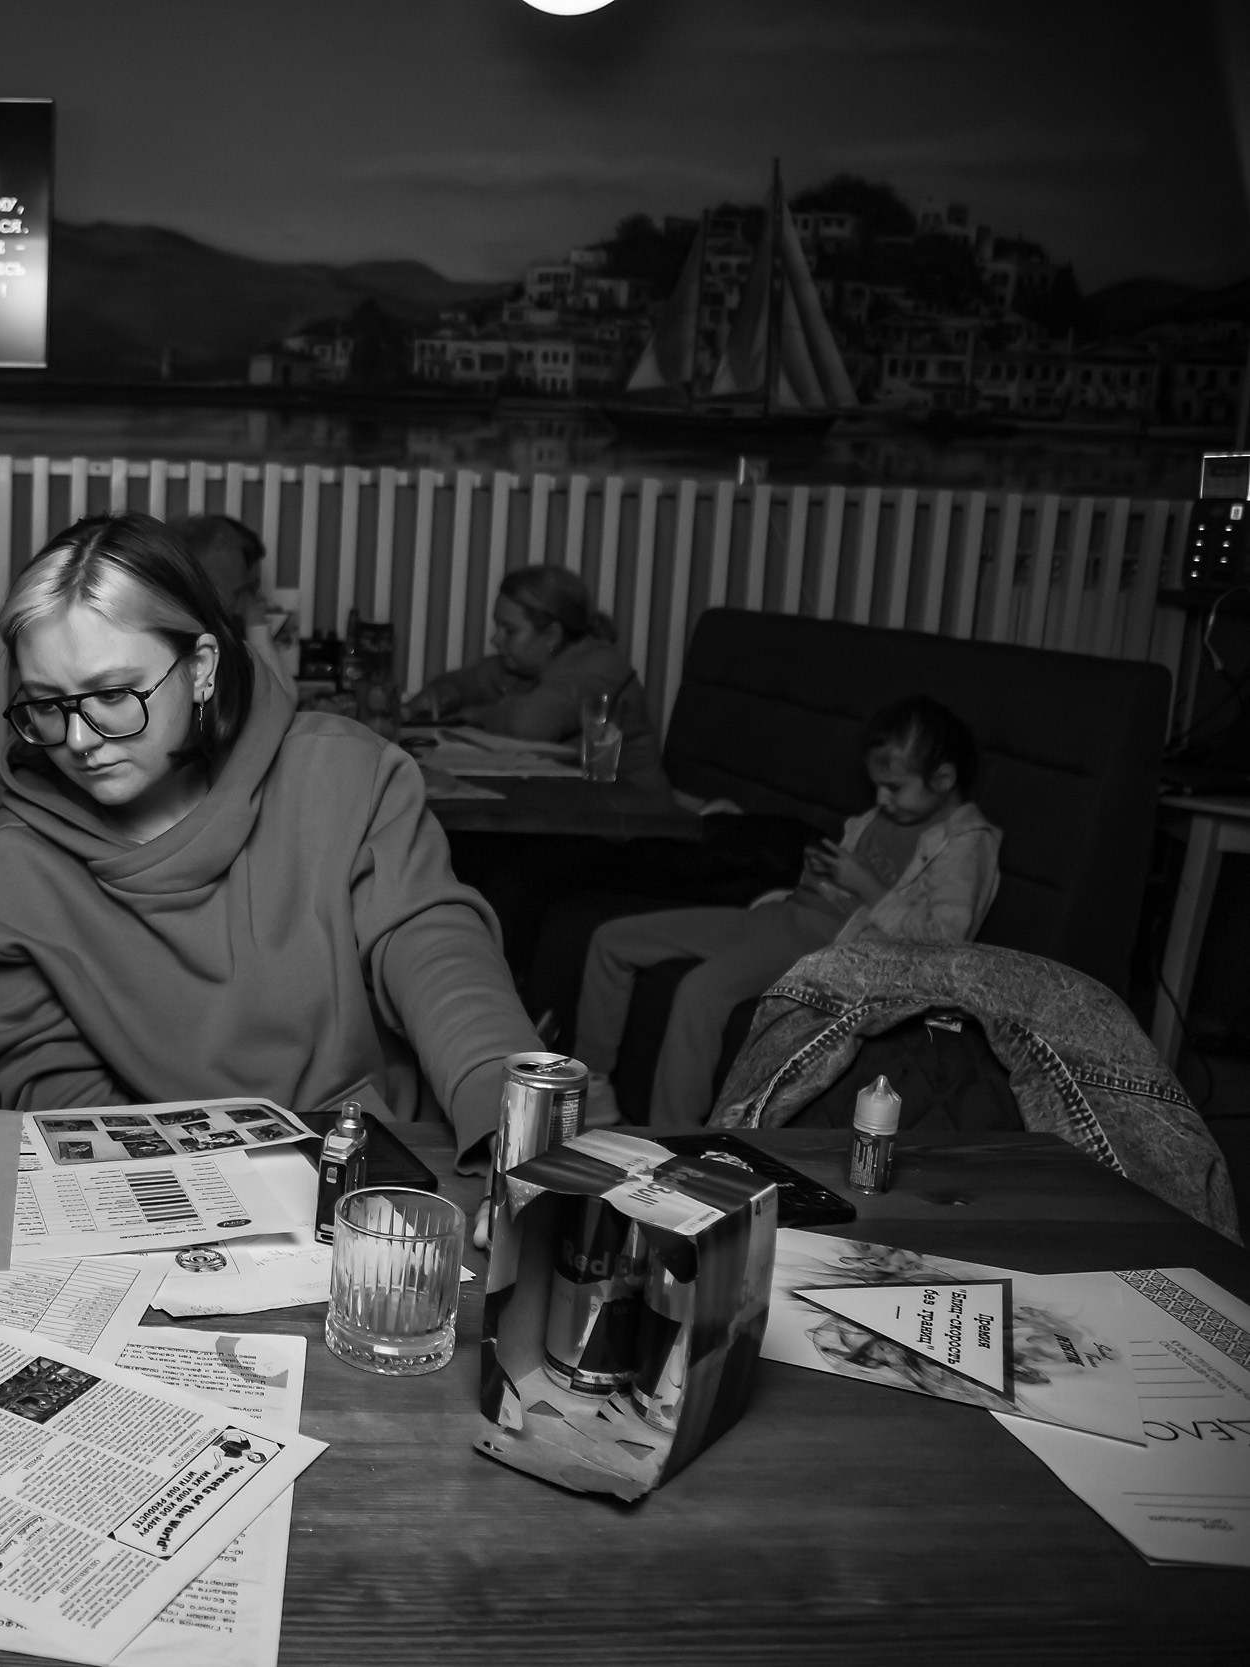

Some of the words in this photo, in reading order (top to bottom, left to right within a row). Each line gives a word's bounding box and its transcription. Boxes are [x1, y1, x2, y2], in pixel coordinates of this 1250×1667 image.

[628, 1183, 675, 1206] Bull
[924, 1288, 940, 1306] без
[917, 1309, 935, 1351] границ"
[948, 1290, 967, 1365] "Блиц-скорость
[974, 1313, 994, 1350] Премия
[182, 1470, 197, 1485] WITH
[195, 1470, 212, 1488] MAKE
[201, 1465, 245, 1495] "Sweets
[167, 1484, 181, 1497] OUR
[176, 1487, 195, 1502] YOUR
[191, 1494, 205, 1506] of
[132, 1497, 168, 1529] PRODUCTS
[160, 1502, 178, 1517] KIDS
[178, 1503, 196, 1517] the
[138, 1516, 162, 1538] HAPPY
[156, 1518, 182, 1552] World"
[59, 1559, 101, 1595] ОБЪЯВЛЕНИЯ
